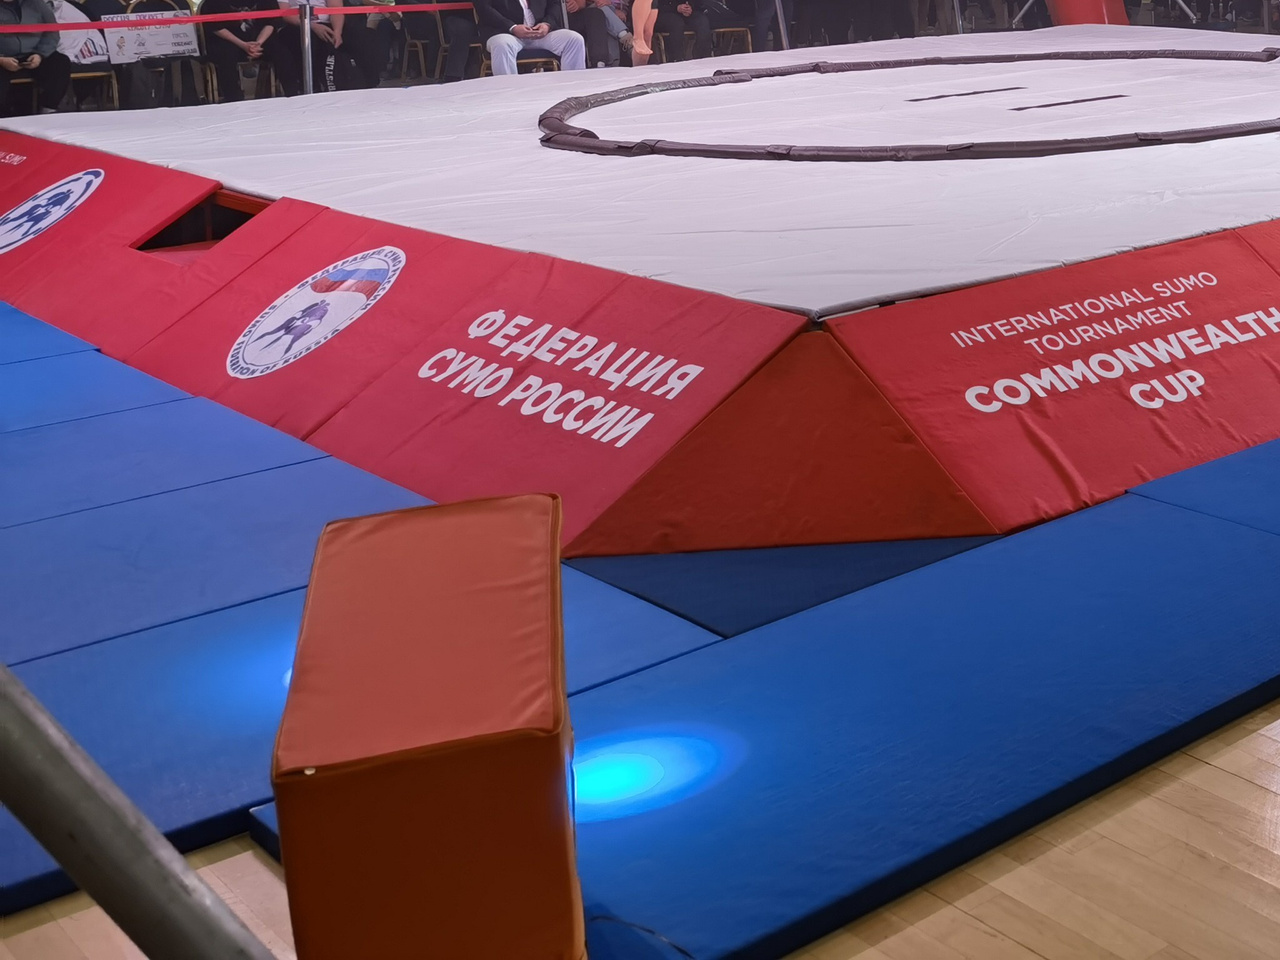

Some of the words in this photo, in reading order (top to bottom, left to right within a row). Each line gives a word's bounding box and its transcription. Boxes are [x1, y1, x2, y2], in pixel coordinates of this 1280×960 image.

[242, 304, 278, 338] SUMO
[950, 288, 1155, 348] INTERNATIONAL
[1151, 271, 1218, 298] SUMO
[1023, 300, 1192, 355] TOURNAMENT
[467, 309, 705, 401] ФЕДЕРАЦИЯ
[417, 347, 515, 398] СУМО
[511, 375, 655, 449] РОССИИ
[1129, 369, 1206, 409] CUP
